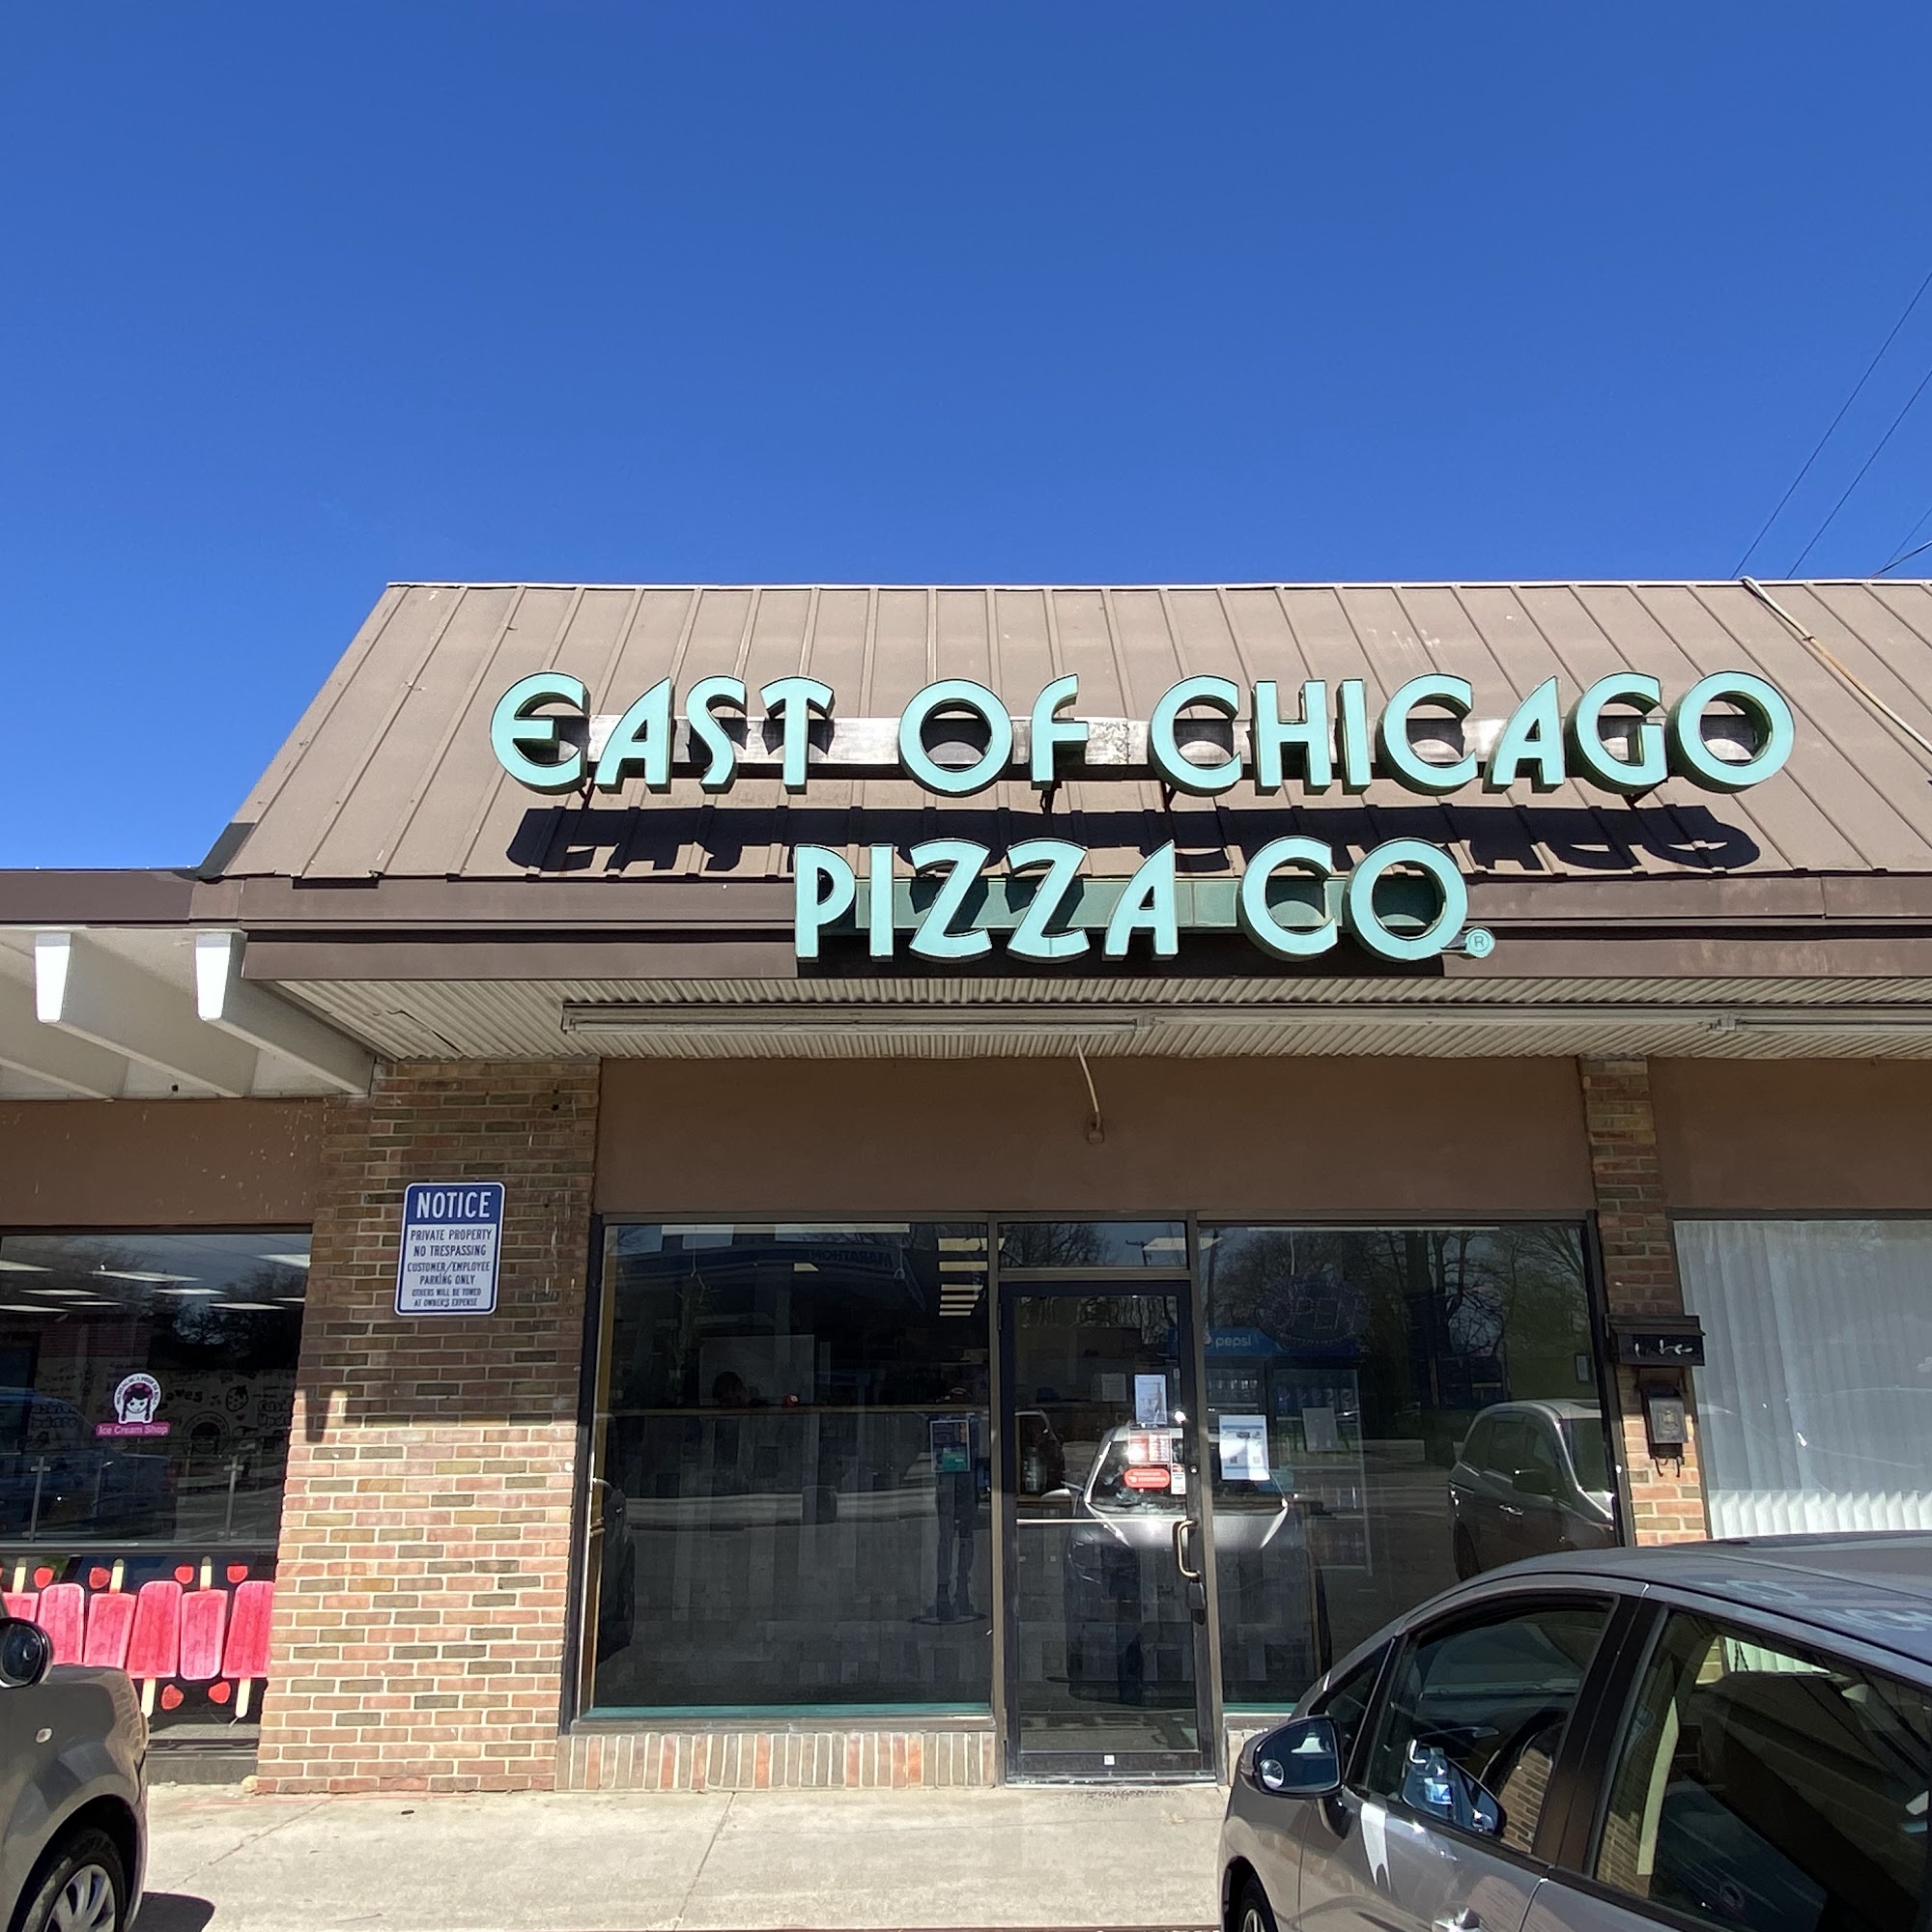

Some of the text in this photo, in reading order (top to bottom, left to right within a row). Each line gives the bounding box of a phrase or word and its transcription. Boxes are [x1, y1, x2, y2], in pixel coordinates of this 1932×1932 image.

[491, 670, 1796, 796] EAST OF CHICAGO
[794, 838, 1179, 962] PIZZA
[1239, 836, 1467, 962] CO
[416, 1192, 492, 1219] NOTICE
[411, 1229, 493, 1241] PRIVATE PROPERTY
[413, 1244, 486, 1257] NO TRESPASSING
[407, 1261, 491, 1274] CUSTOMER/EMPLOYEE
[419, 1274, 475, 1285] PARKING ONLY
[1215, 1335, 1252, 1350] pepsi
[98, 1425, 168, 1435] Ice Cream Shop
